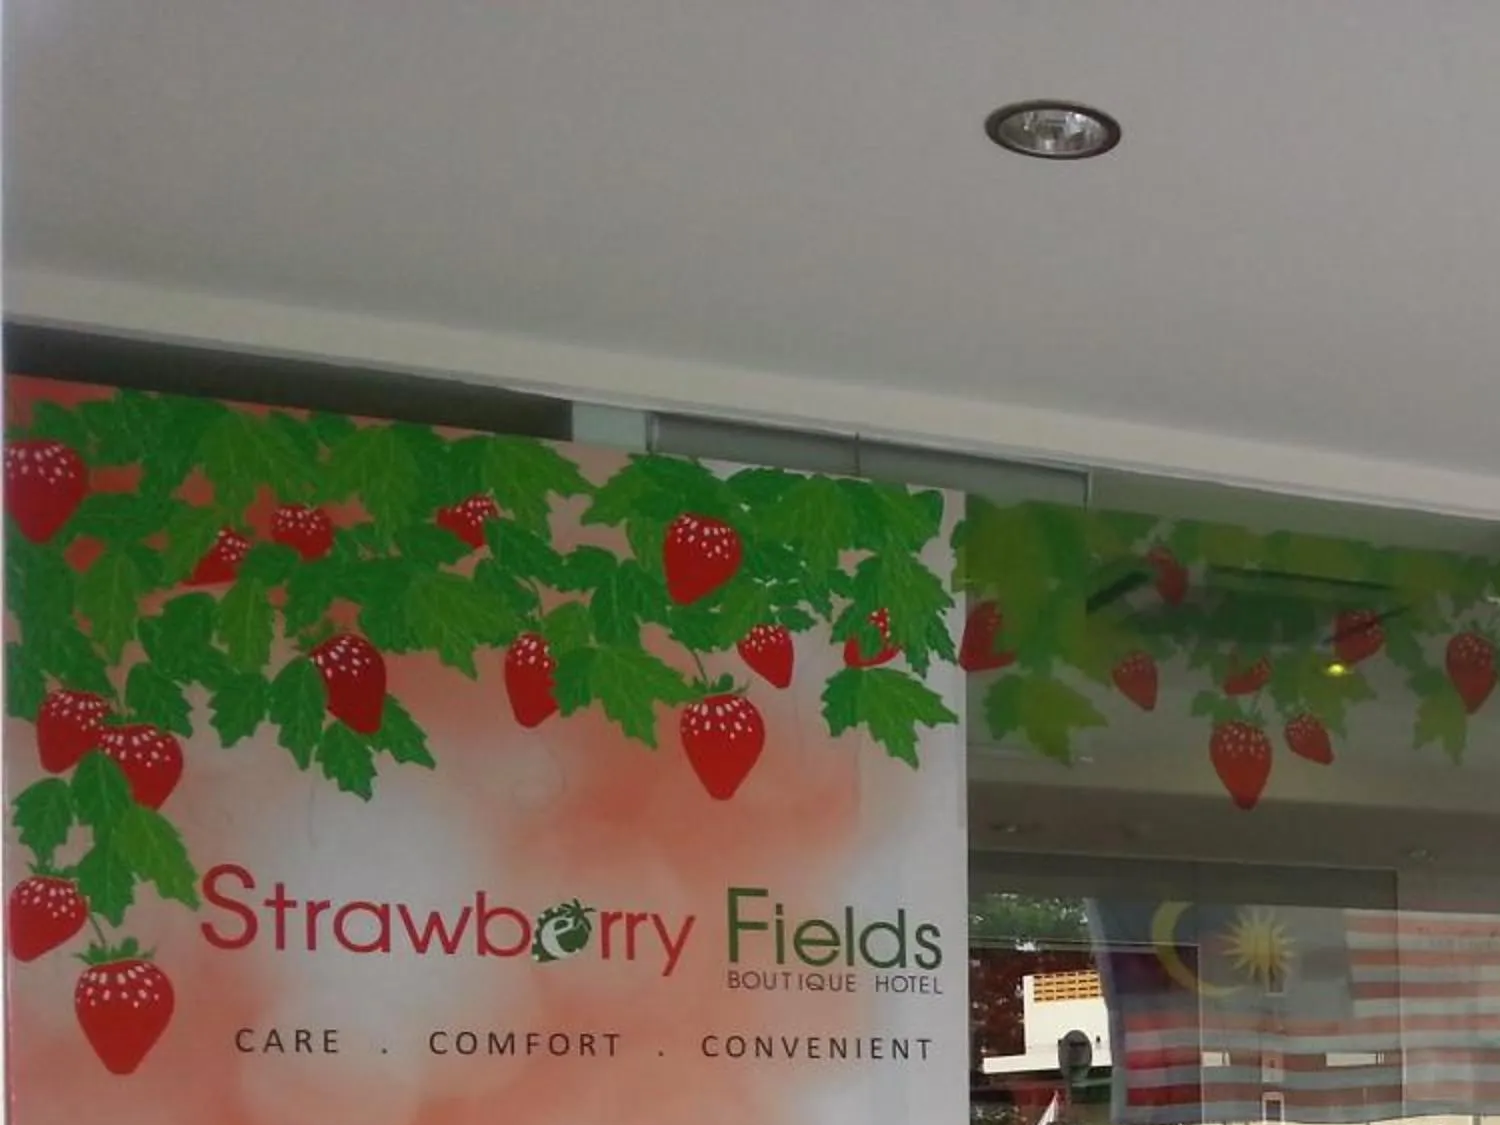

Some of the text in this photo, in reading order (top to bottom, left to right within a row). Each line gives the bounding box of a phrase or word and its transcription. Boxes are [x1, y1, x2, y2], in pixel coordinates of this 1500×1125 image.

[200, 863, 943, 976] Strawberry Fields
[727, 970, 943, 995] BOUTIQUE HOTEL
[235, 1027, 341, 1055] CARE
[429, 1030, 621, 1057] COMFORT
[701, 1035, 934, 1061] CONVENIENT
